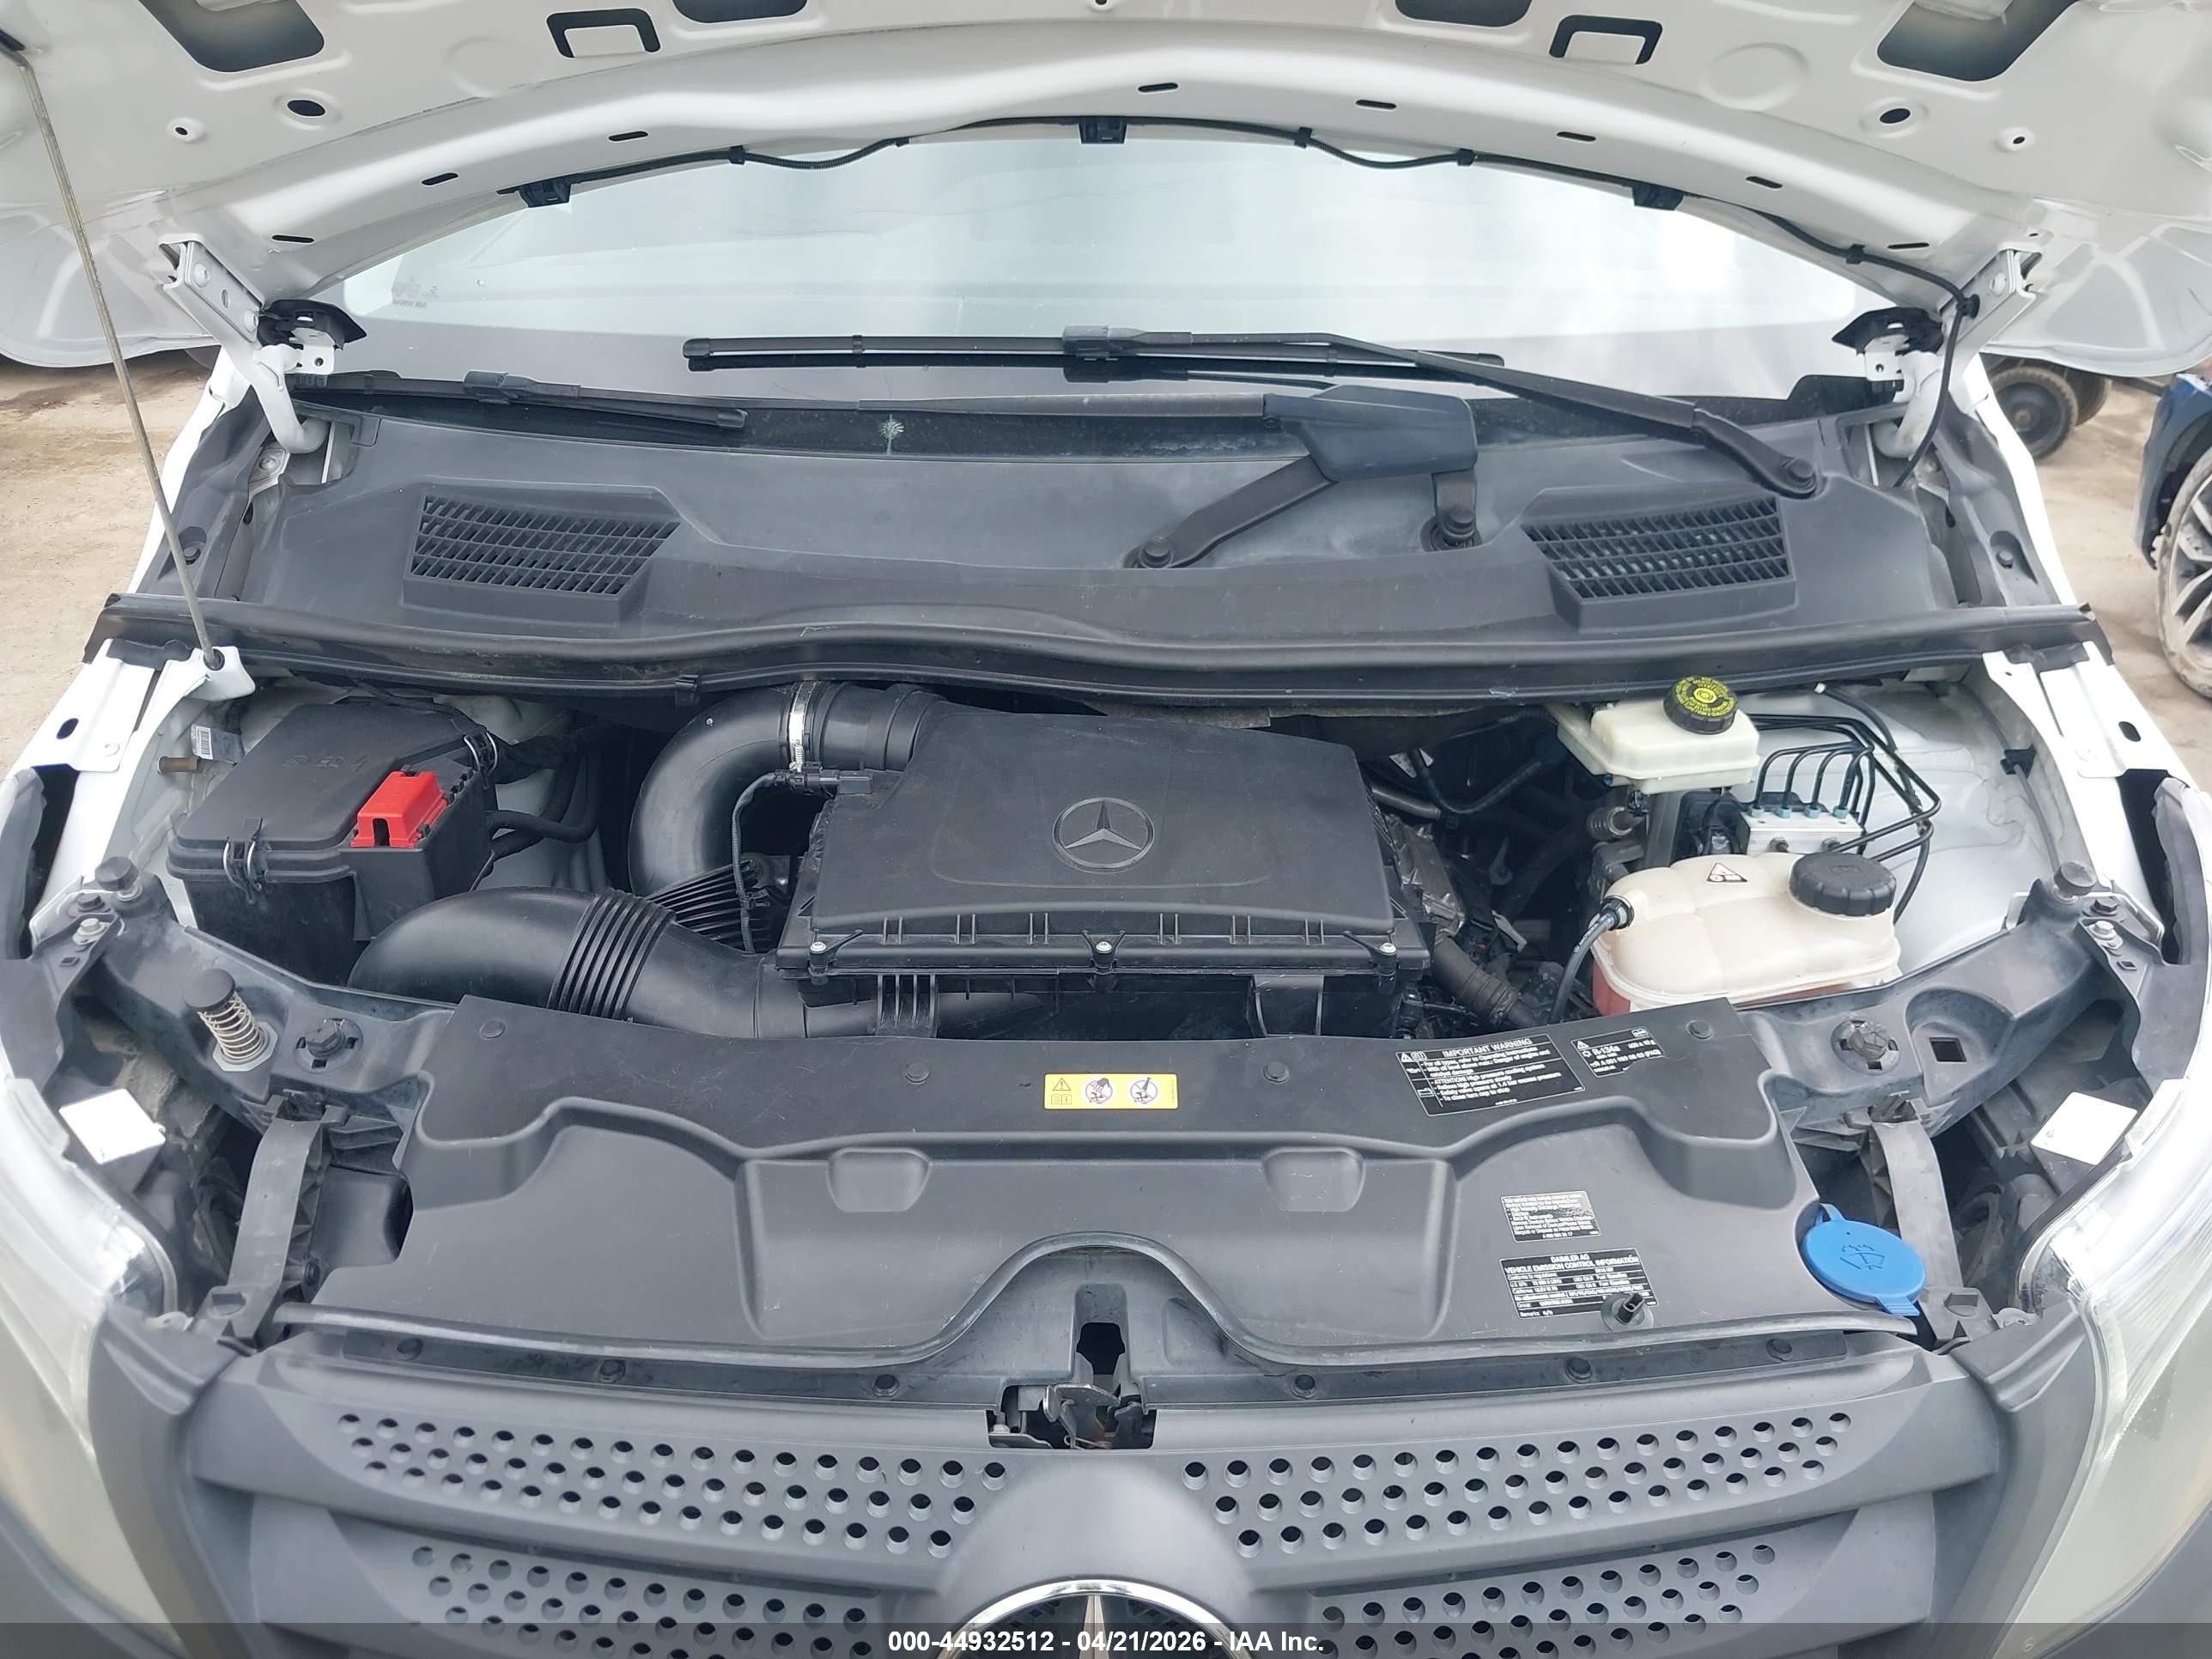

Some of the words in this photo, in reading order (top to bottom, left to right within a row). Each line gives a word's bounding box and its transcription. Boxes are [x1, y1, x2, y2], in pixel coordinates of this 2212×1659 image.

[1442, 1046, 1491, 1057] IMPORTANT
[1491, 1038, 1532, 1051] WARNING
[1479, 1052, 1506, 1061] Operating
[1505, 1047, 1538, 1056] Instructions
[1592, 1046, 1621, 1055] R-134a
[1533, 1263, 1565, 1272] EMISSION
[1565, 1261, 1595, 1269] CONTROL
[1595, 1256, 1638, 1267] INFORMATION
